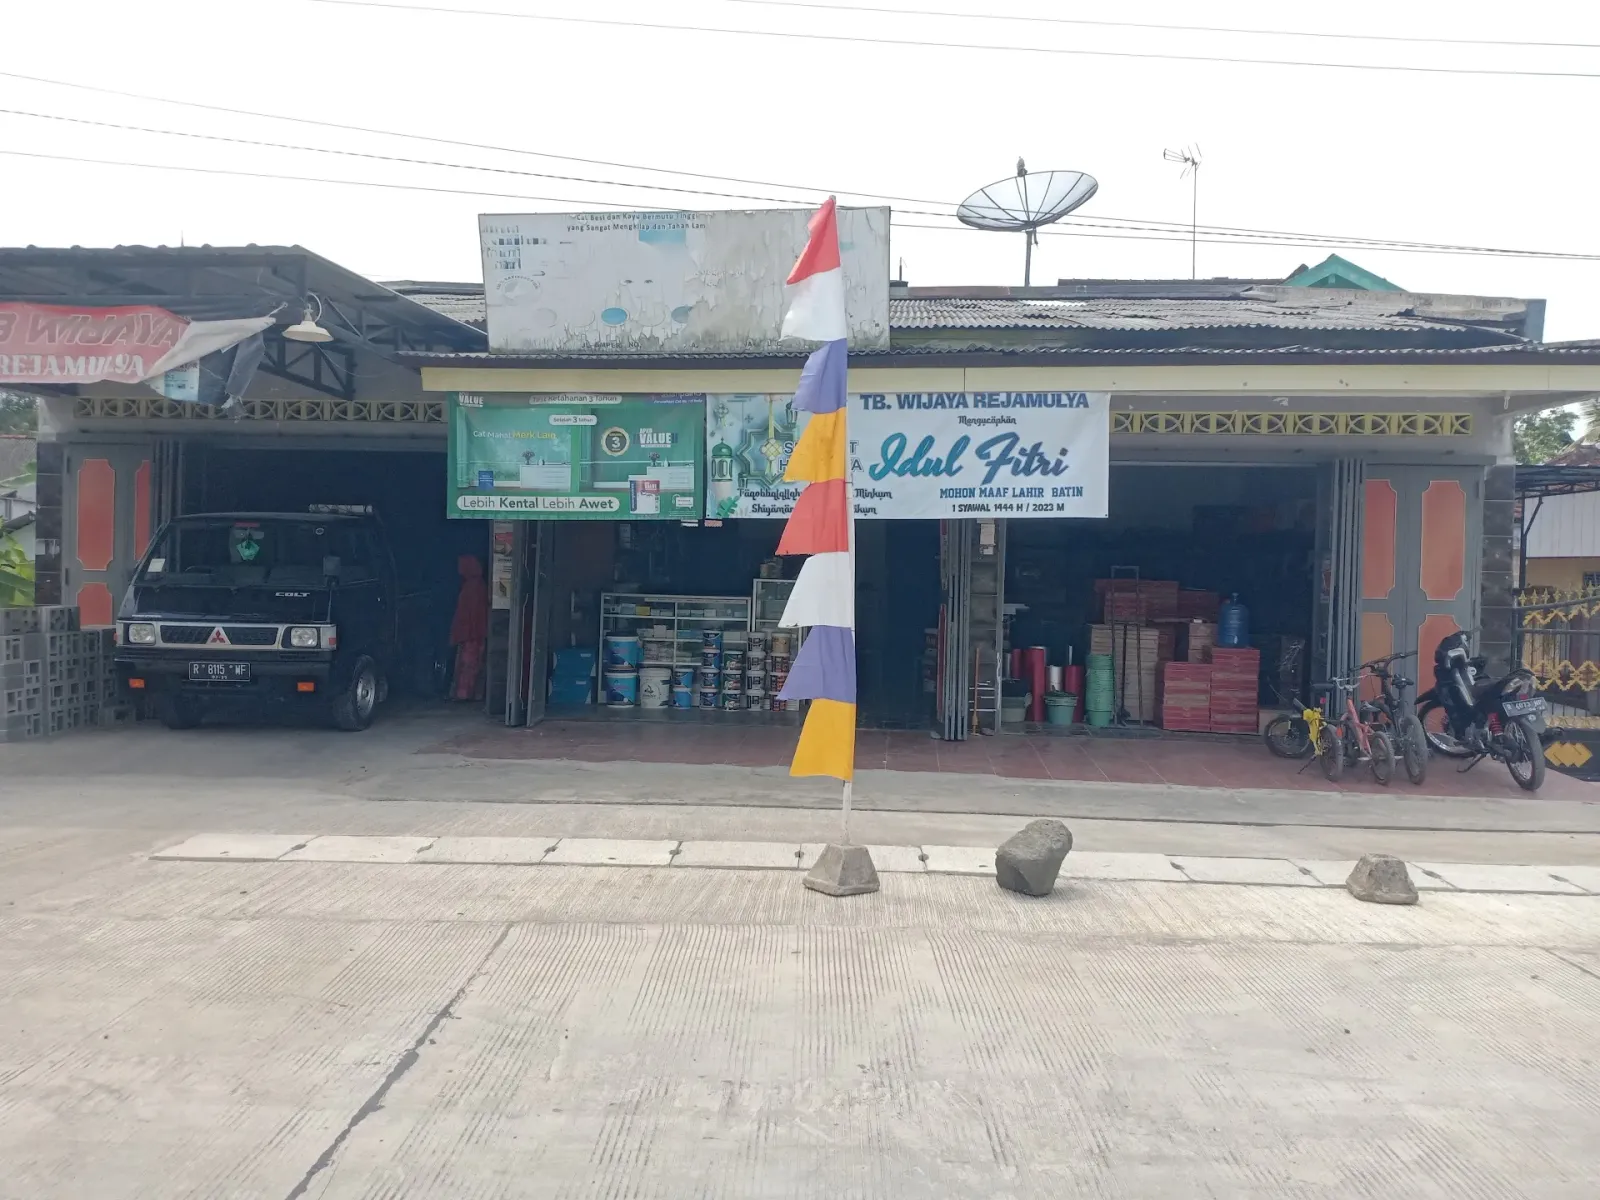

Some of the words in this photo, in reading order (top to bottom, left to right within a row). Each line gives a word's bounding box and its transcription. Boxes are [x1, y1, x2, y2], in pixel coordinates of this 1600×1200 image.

[623, 213, 640, 221] Kayu
[586, 224, 611, 232] Sangat
[613, 223, 650, 231] Mengkilap
[859, 393, 892, 411] TB.
[897, 392, 969, 410] WIJAYA
[973, 391, 1090, 409] REJAMULYA
[473, 430, 486, 438] Cat
[487, 431, 512, 439] Mahal
[513, 430, 535, 438] Merk
[537, 430, 556, 439] Lain
[640, 432, 671, 444] VALUE
[611, 436, 621, 449] 3
[868, 431, 972, 482] Idul
[975, 431, 1070, 486] Fitri
[940, 487, 976, 499] MOHON
[979, 486, 1009, 498] MAAF
[1012, 486, 1045, 498] LAHIR
[1052, 486, 1084, 498] BATIN
[463, 496, 495, 509] Lebih
[499, 496, 539, 509] Kental
[542, 496, 575, 509] Lebih
[579, 498, 614, 509] Awet
[952, 504, 956, 512] 1
[958, 503, 991, 513] SYAWAL
[994, 503, 1014, 512] 1444
[1016, 503, 1024, 512] H
[1032, 503, 1054, 512] 2023
[1056, 503, 1065, 512] M
[193, 663, 199, 675] R
